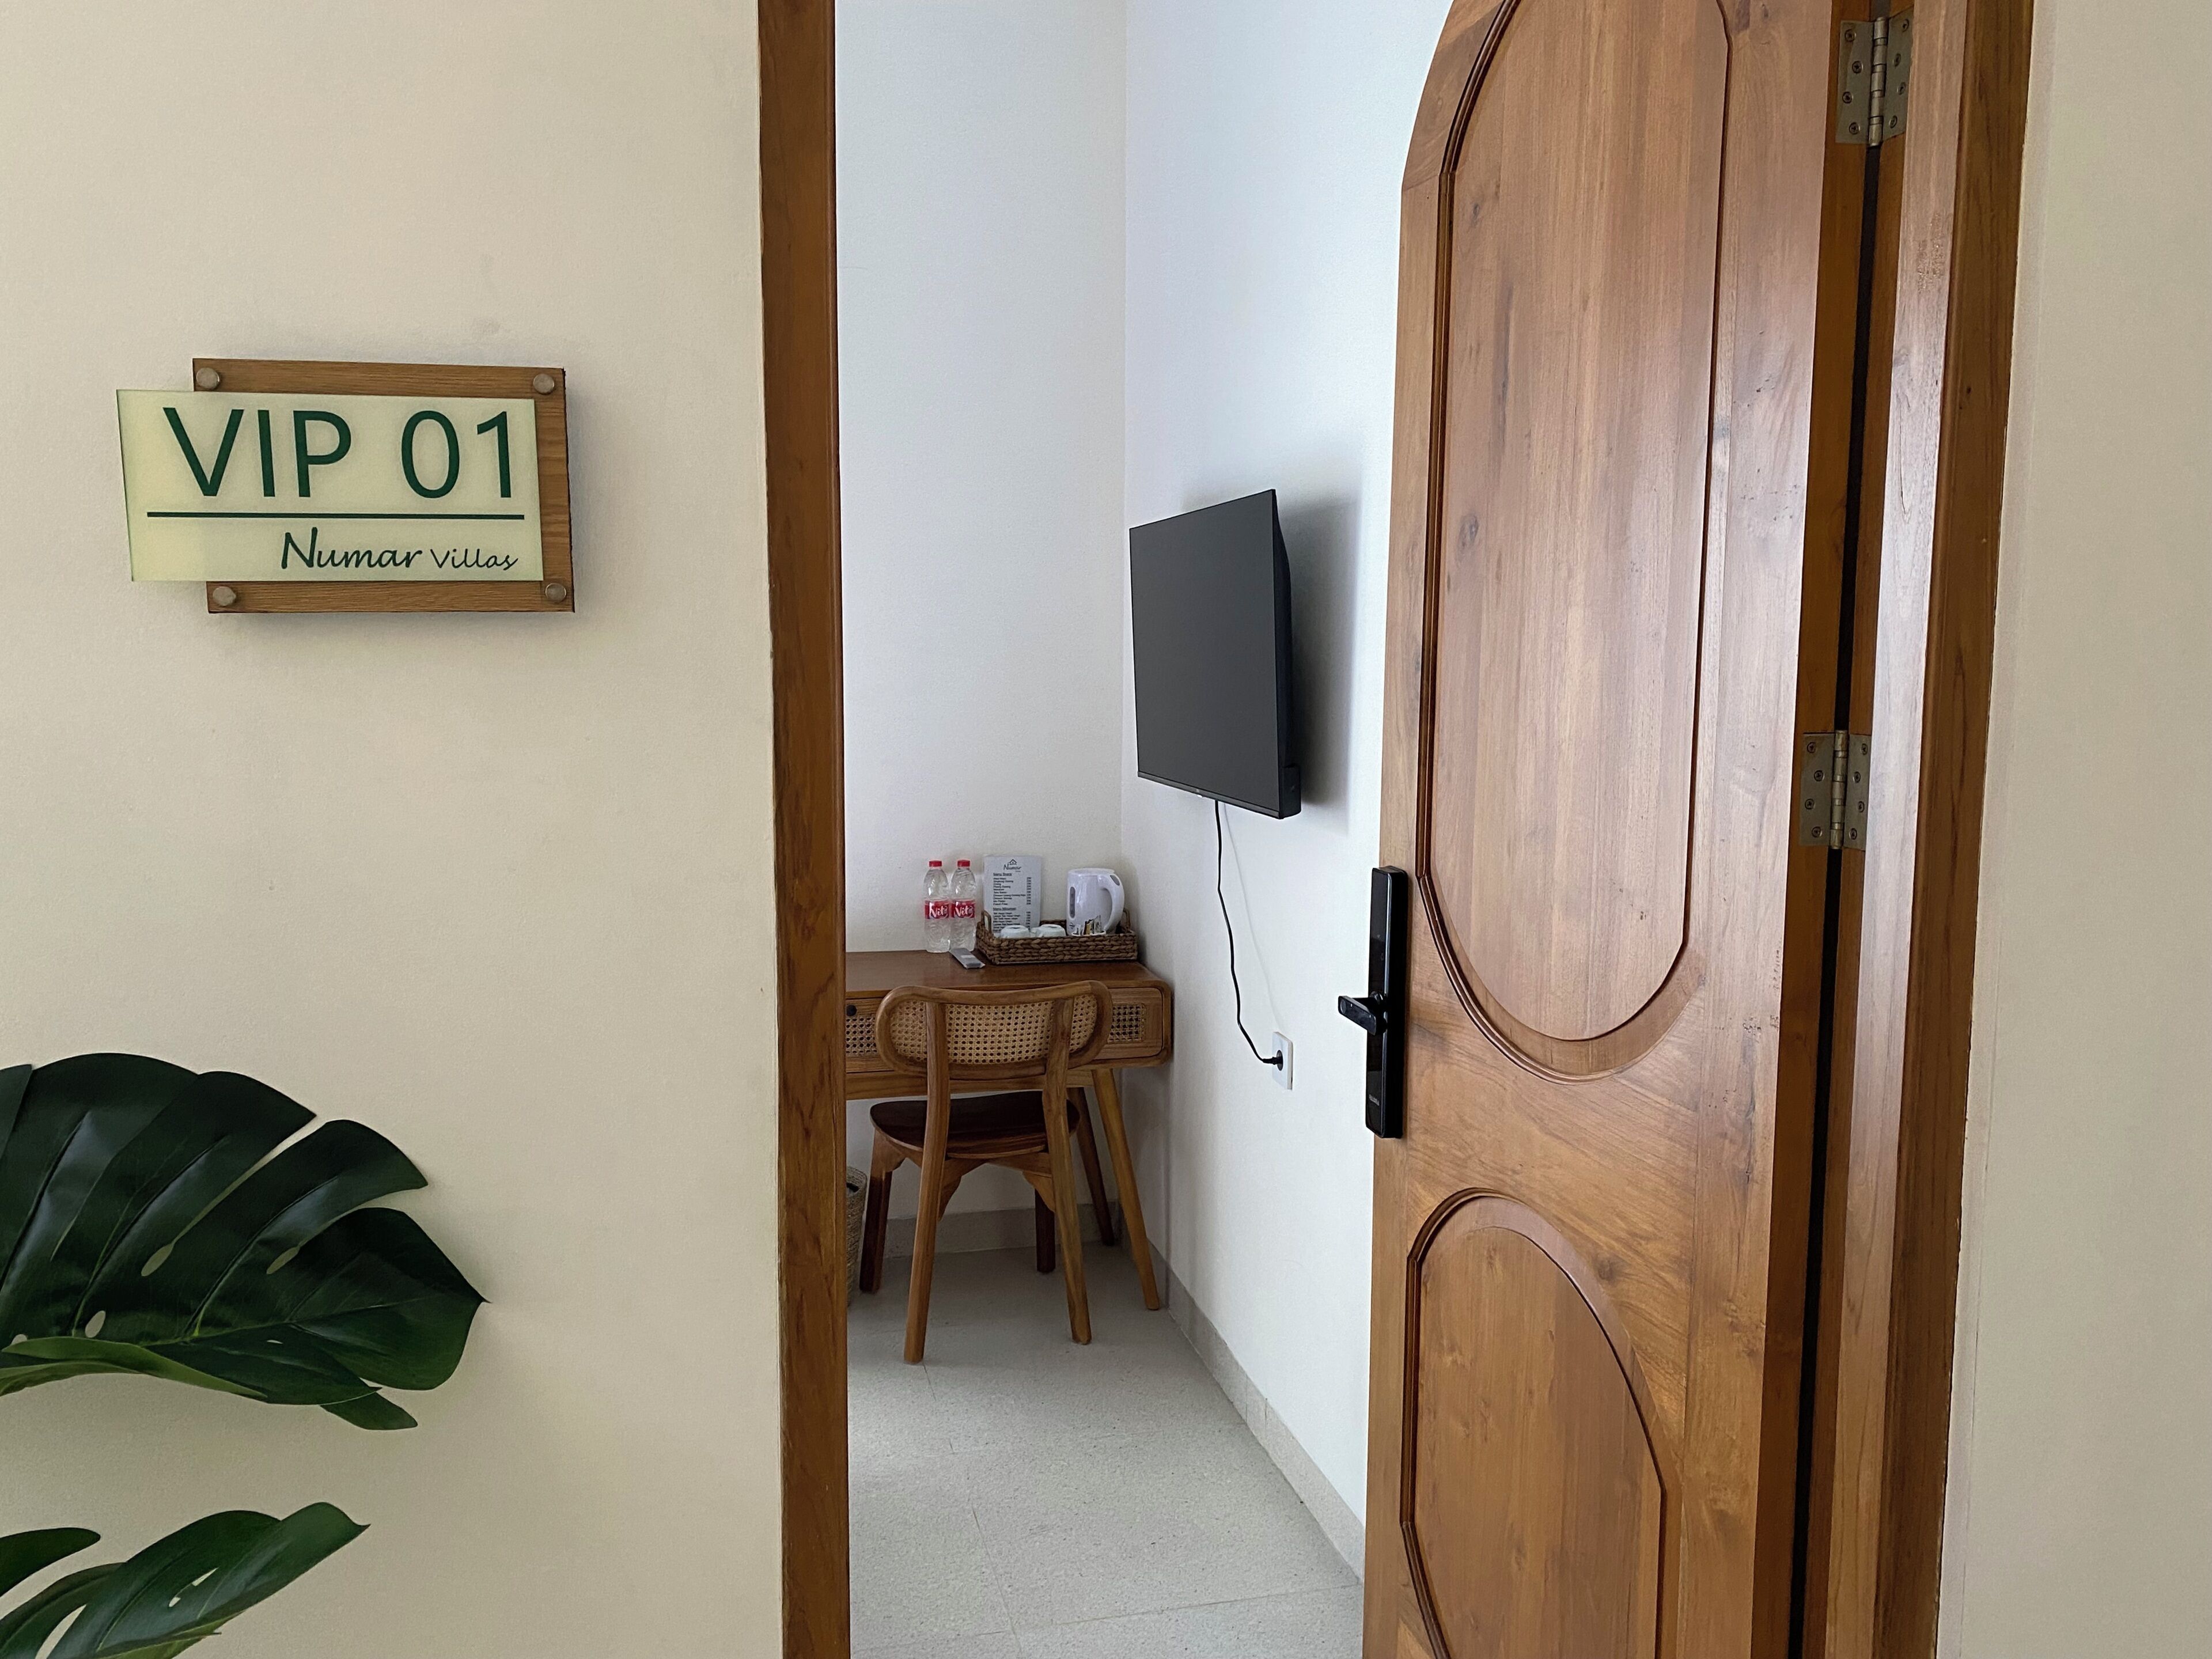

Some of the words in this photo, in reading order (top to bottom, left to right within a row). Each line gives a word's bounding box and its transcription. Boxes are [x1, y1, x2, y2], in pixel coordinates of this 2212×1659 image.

[164, 407, 352, 498] VIP
[401, 410, 512, 498] 01
[281, 527, 423, 569] Numar
[430, 548, 518, 570] Villas
